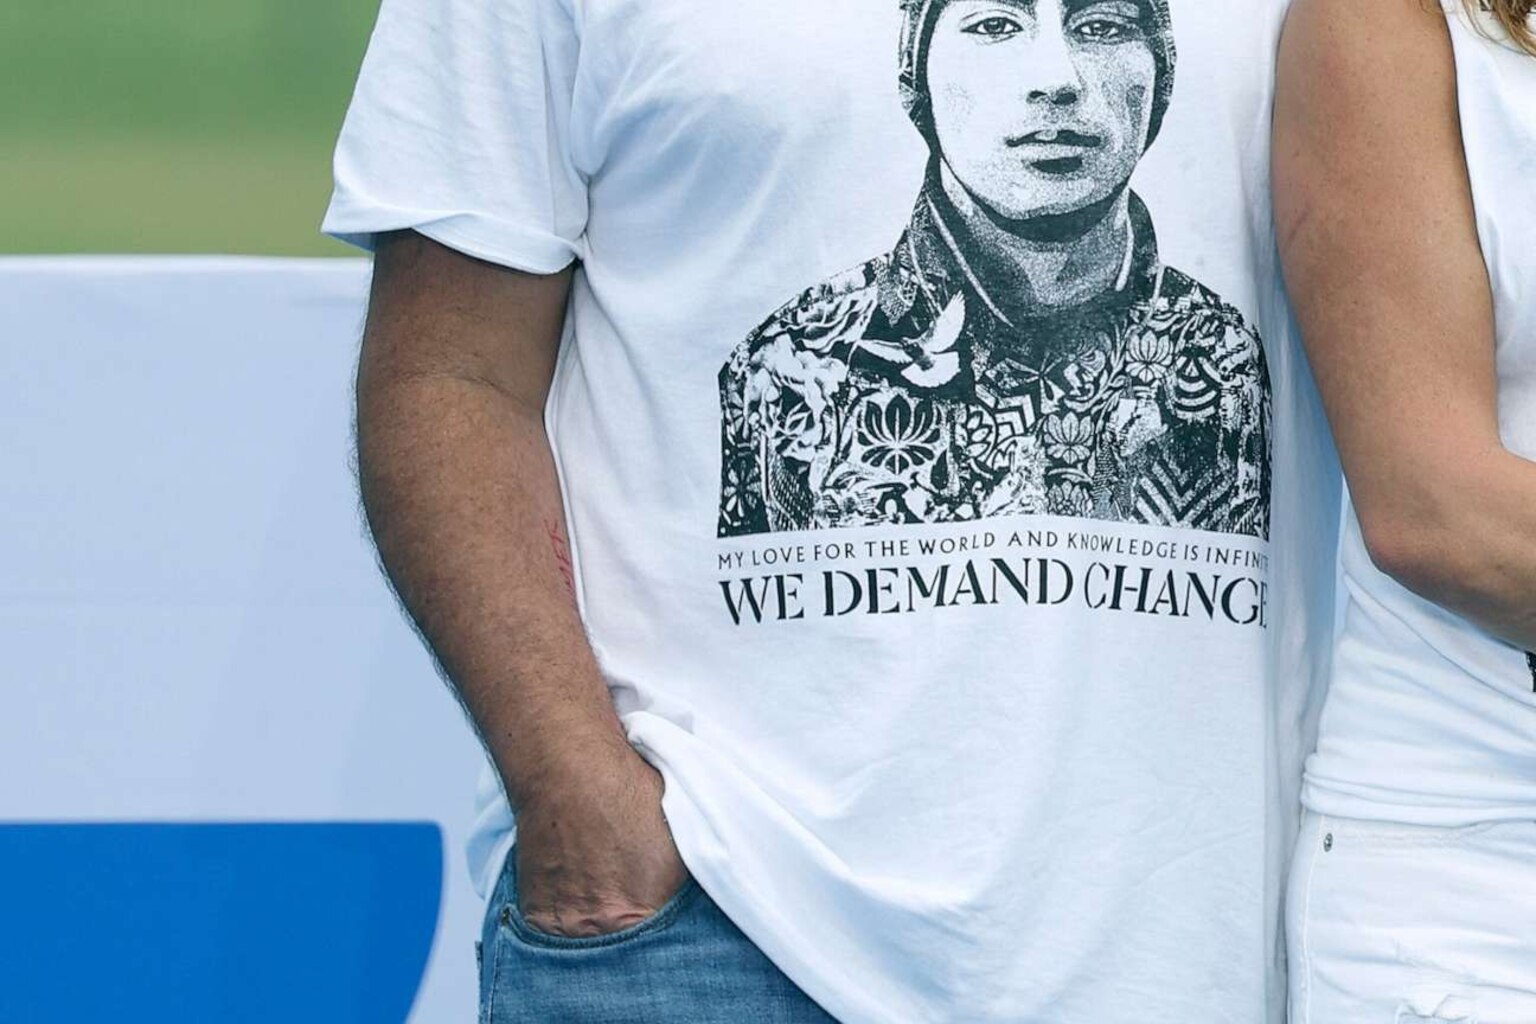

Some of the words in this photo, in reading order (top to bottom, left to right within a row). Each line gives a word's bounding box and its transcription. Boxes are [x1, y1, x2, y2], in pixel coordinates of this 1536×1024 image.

[718, 551, 745, 570] MY
[752, 545, 805, 566] LOVE
[813, 542, 856, 562] FOR
[864, 539, 910, 558] THE
[918, 532, 995, 556] WORLD
[1007, 530, 1058, 548] AND
[1067, 531, 1177, 560] KNOWLEDGE
[1184, 544, 1199, 562] IS
[718, 573, 805, 626] WE
[822, 557, 1074, 617] DEMAND
